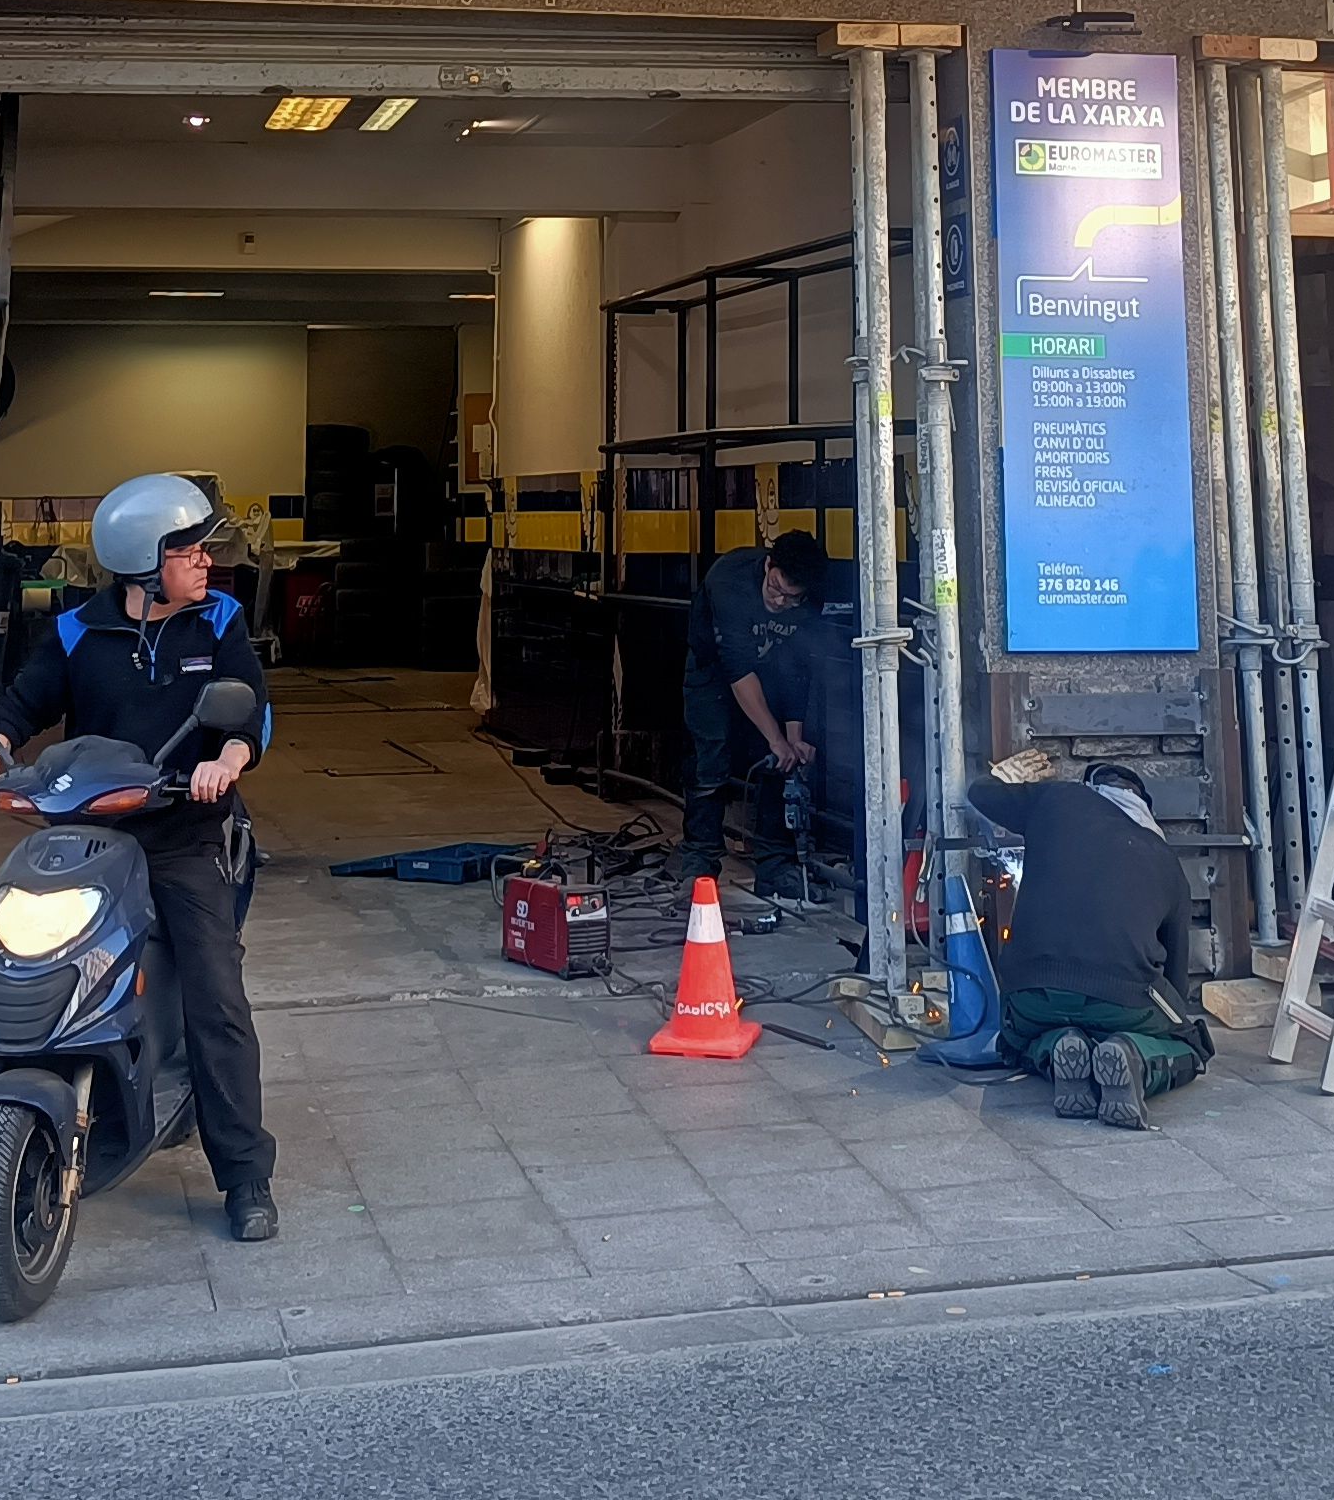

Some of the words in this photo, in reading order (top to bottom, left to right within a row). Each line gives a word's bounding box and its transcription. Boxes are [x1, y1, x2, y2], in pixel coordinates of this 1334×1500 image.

[1037, 76, 1137, 101] MEMBRE
[1010, 101, 1041, 124] DE
[1048, 102, 1076, 125] LA
[1082, 104, 1165, 128] XARXA
[1049, 145, 1157, 164] EUROMASTER
[1028, 293, 1140, 322] Benvingut
[1030, 337, 1095, 357] HORARI
[1032, 366, 1069, 379] Dilluns
[1072, 369, 1080, 379] a
[1082, 366, 1135, 381] Dissabtes
[1032, 381, 1073, 393] 09:00h
[1076, 384, 1084, 393] a
[1085, 382, 1126, 394] 13:00h
[1033, 395, 1074, 407] 15:00h
[1076, 398, 1084, 407] a
[1086, 395, 1127, 408] 19:00h
[1033, 420, 1107, 436] PNEUMÀTICS
[1033, 437, 1070, 450] CANVI
[1034, 451, 1110, 465] AMORTIDORS
[1035, 466, 1073, 478] FRENS
[1035, 479, 1080, 493] REVISIÓ
[1083, 480, 1127, 494] OFICIAL
[1036, 493, 1096, 508] ALINEACIÓ
[1038, 579, 1063, 592] 376
[1066, 579, 1091, 592] 820
[1095, 579, 1119, 592] 146
[1038, 592, 1128, 605] euromaster.com
